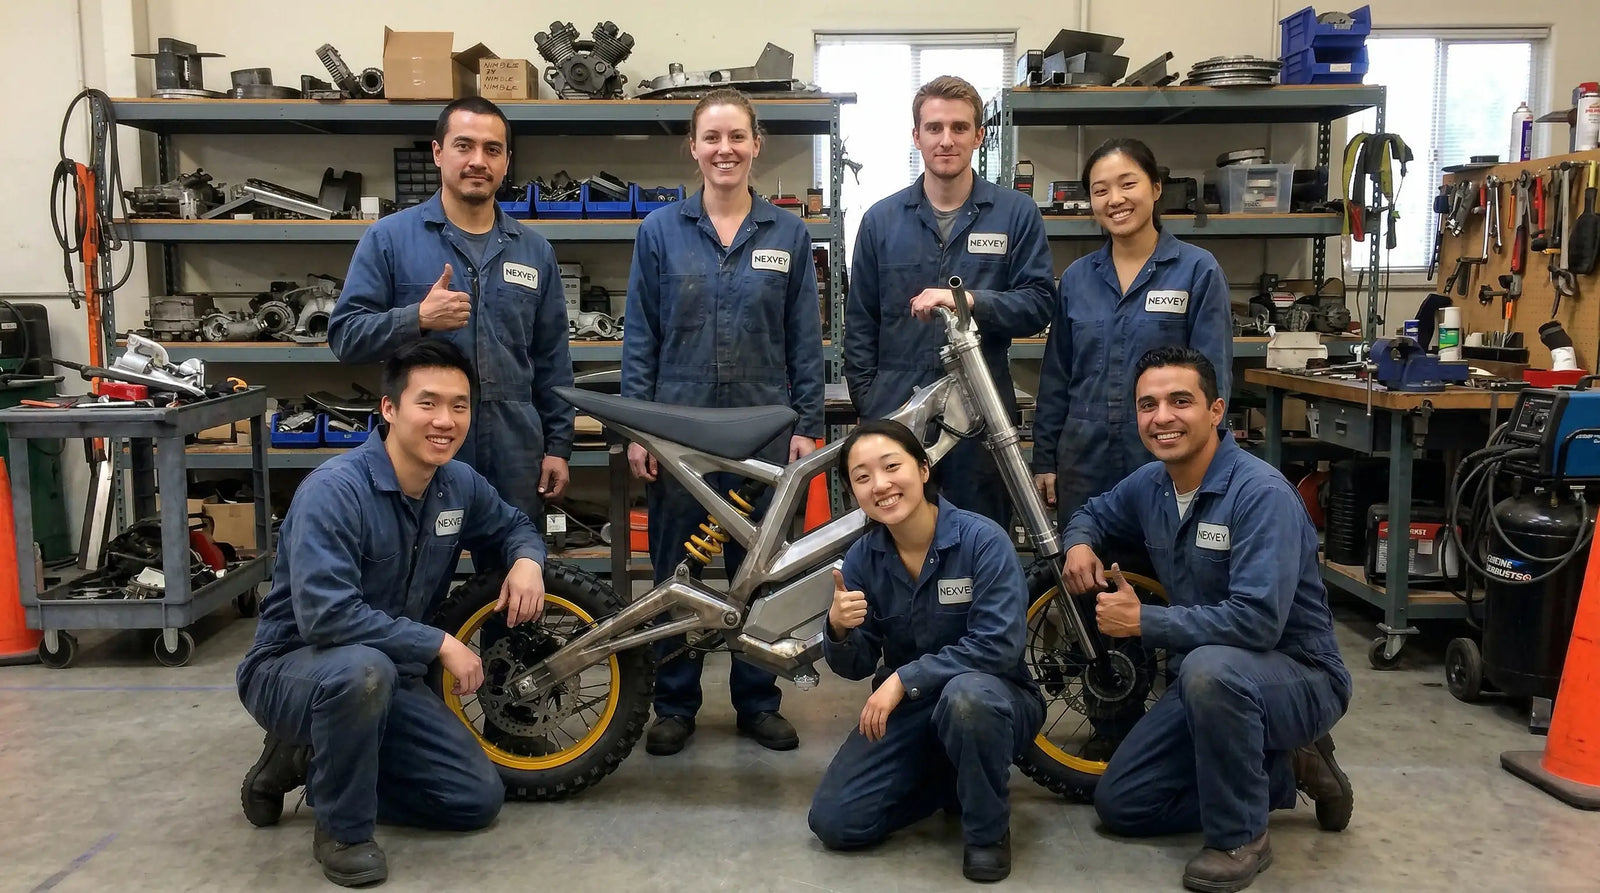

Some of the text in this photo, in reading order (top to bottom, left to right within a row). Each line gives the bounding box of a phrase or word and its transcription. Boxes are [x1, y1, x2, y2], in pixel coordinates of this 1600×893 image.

[970, 239, 1005, 248] NEXVEY
[754, 255, 788, 266] NEXVEY
[505, 268, 536, 282] NEXVEY
[1148, 296, 1186, 306] NEXVEY
[438, 516, 463, 528] NEXVE
[940, 585, 974, 596] NEXVE
